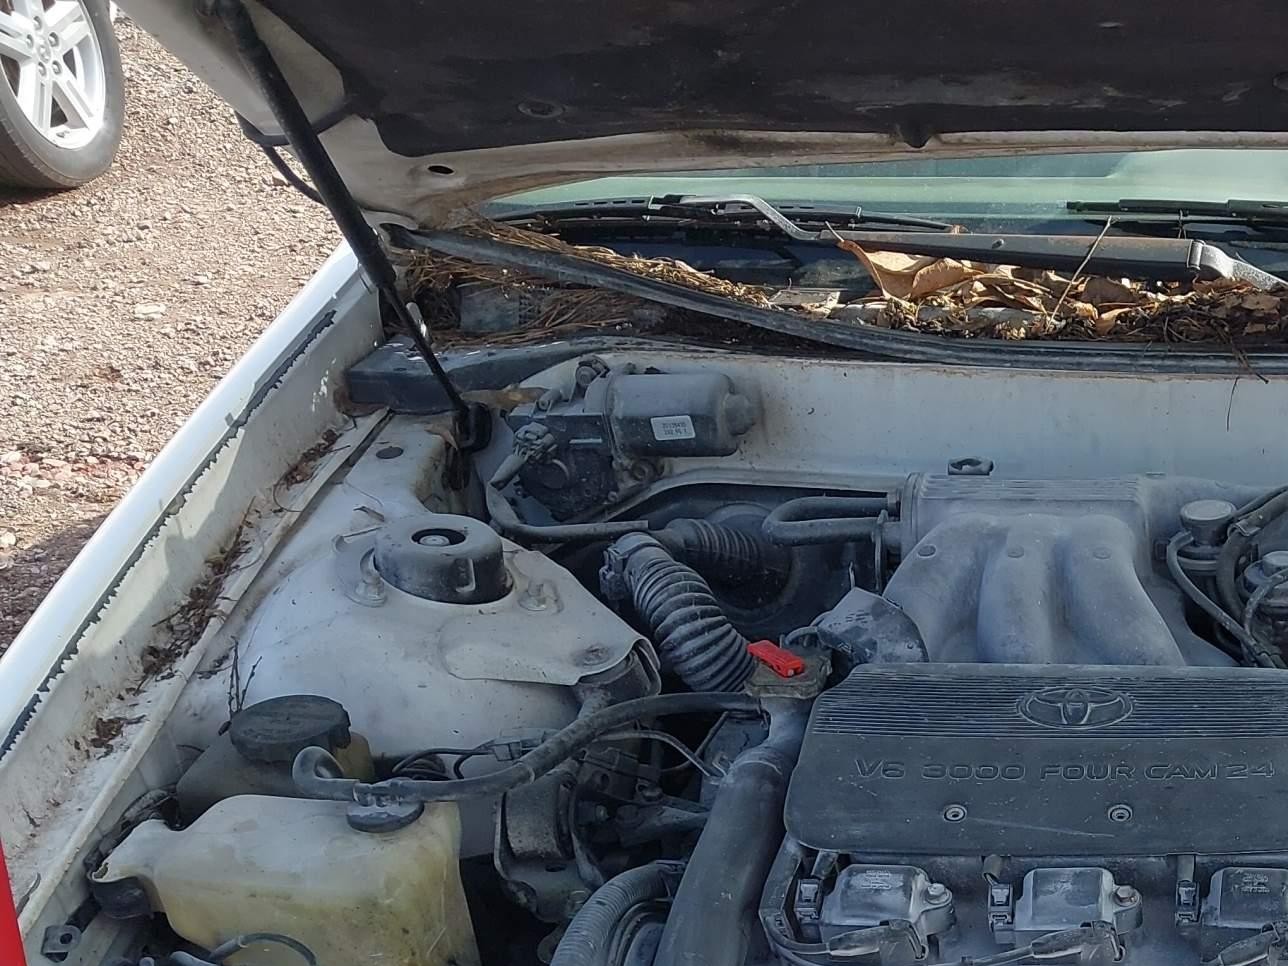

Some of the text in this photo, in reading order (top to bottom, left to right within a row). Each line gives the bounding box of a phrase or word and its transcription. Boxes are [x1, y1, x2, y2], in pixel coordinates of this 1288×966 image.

[856, 759, 1276, 781] V6 3000 FOUR CAM 24
